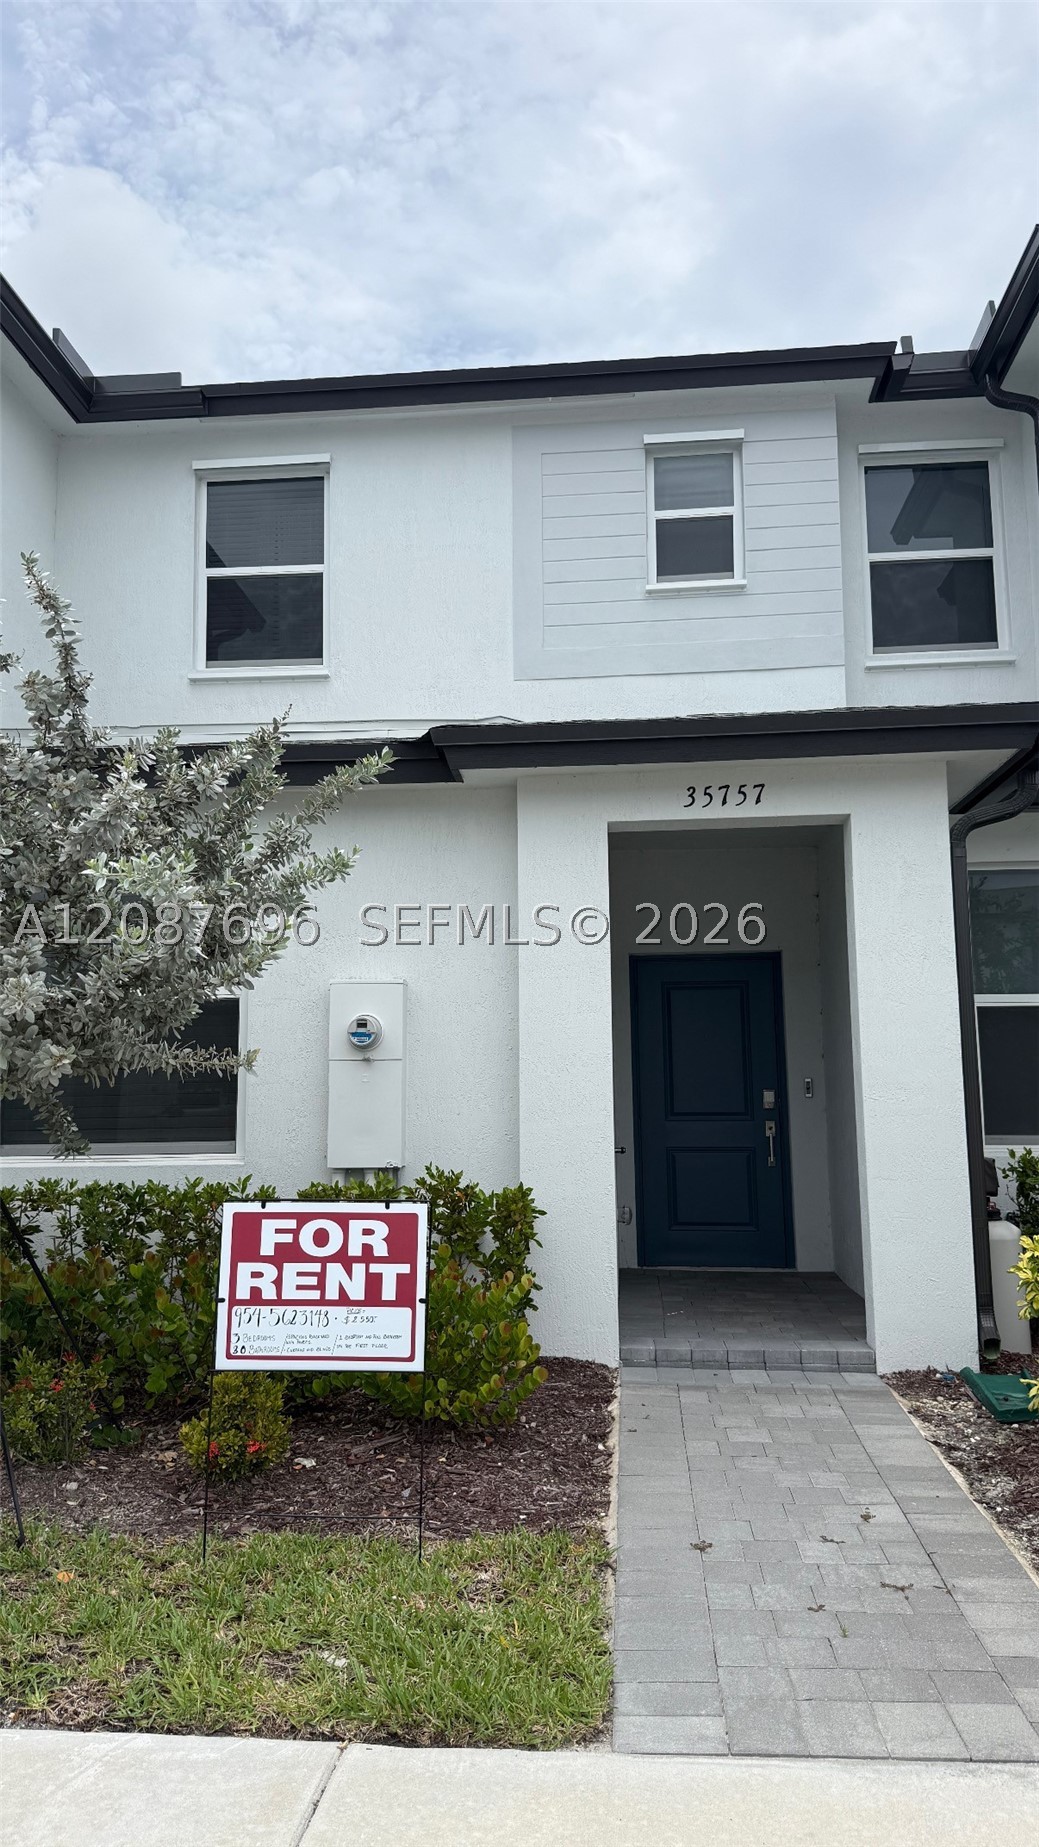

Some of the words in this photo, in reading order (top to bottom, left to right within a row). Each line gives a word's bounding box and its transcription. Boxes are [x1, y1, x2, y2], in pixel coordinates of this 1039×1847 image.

[683, 783, 766, 808] 35757
[259, 1218, 389, 1257] FOR
[235, 1262, 411, 1301] RENT
[234, 1307, 329, 1328] 954-5623148
[232, 1333, 241, 1344] 3
